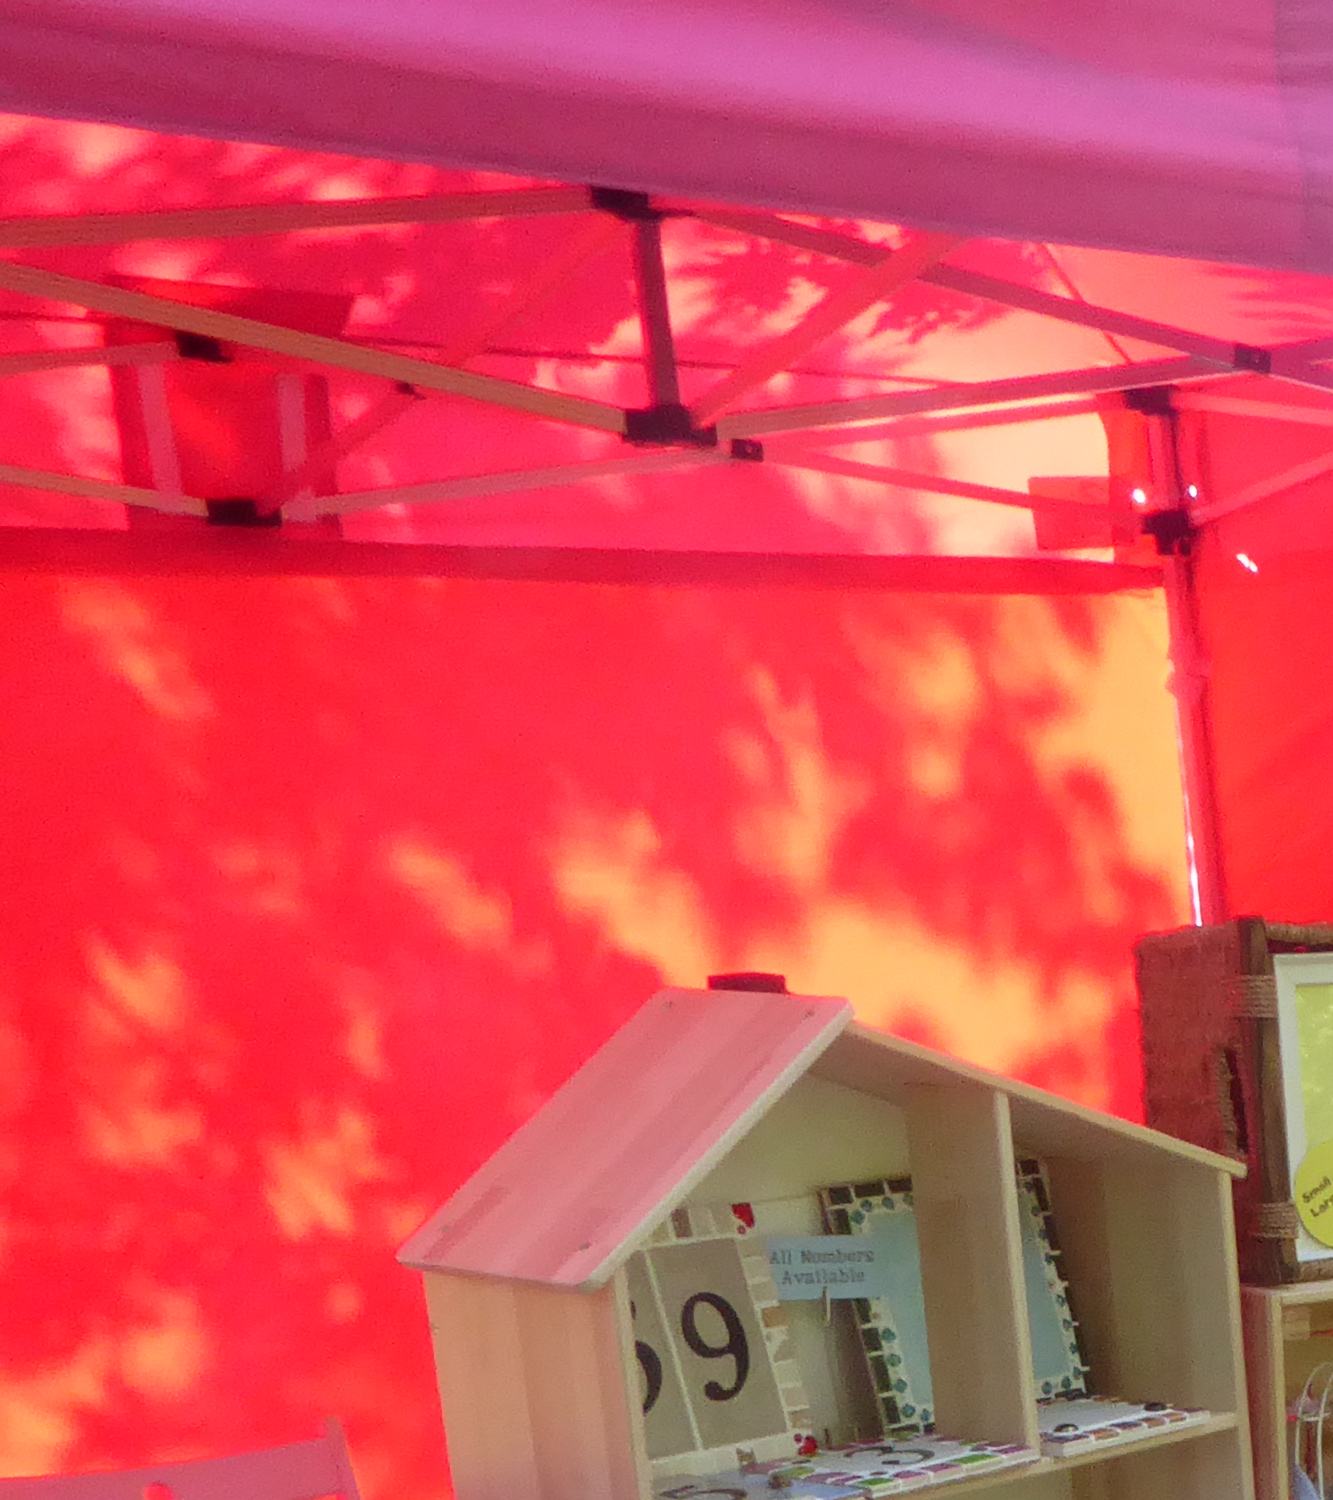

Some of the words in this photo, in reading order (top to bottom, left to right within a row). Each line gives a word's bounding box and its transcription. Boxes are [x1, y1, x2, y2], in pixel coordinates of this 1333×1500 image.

[769, 1249, 792, 1265] All
[800, 1248, 875, 1263] Numbers
[782, 1268, 866, 1285] Available
